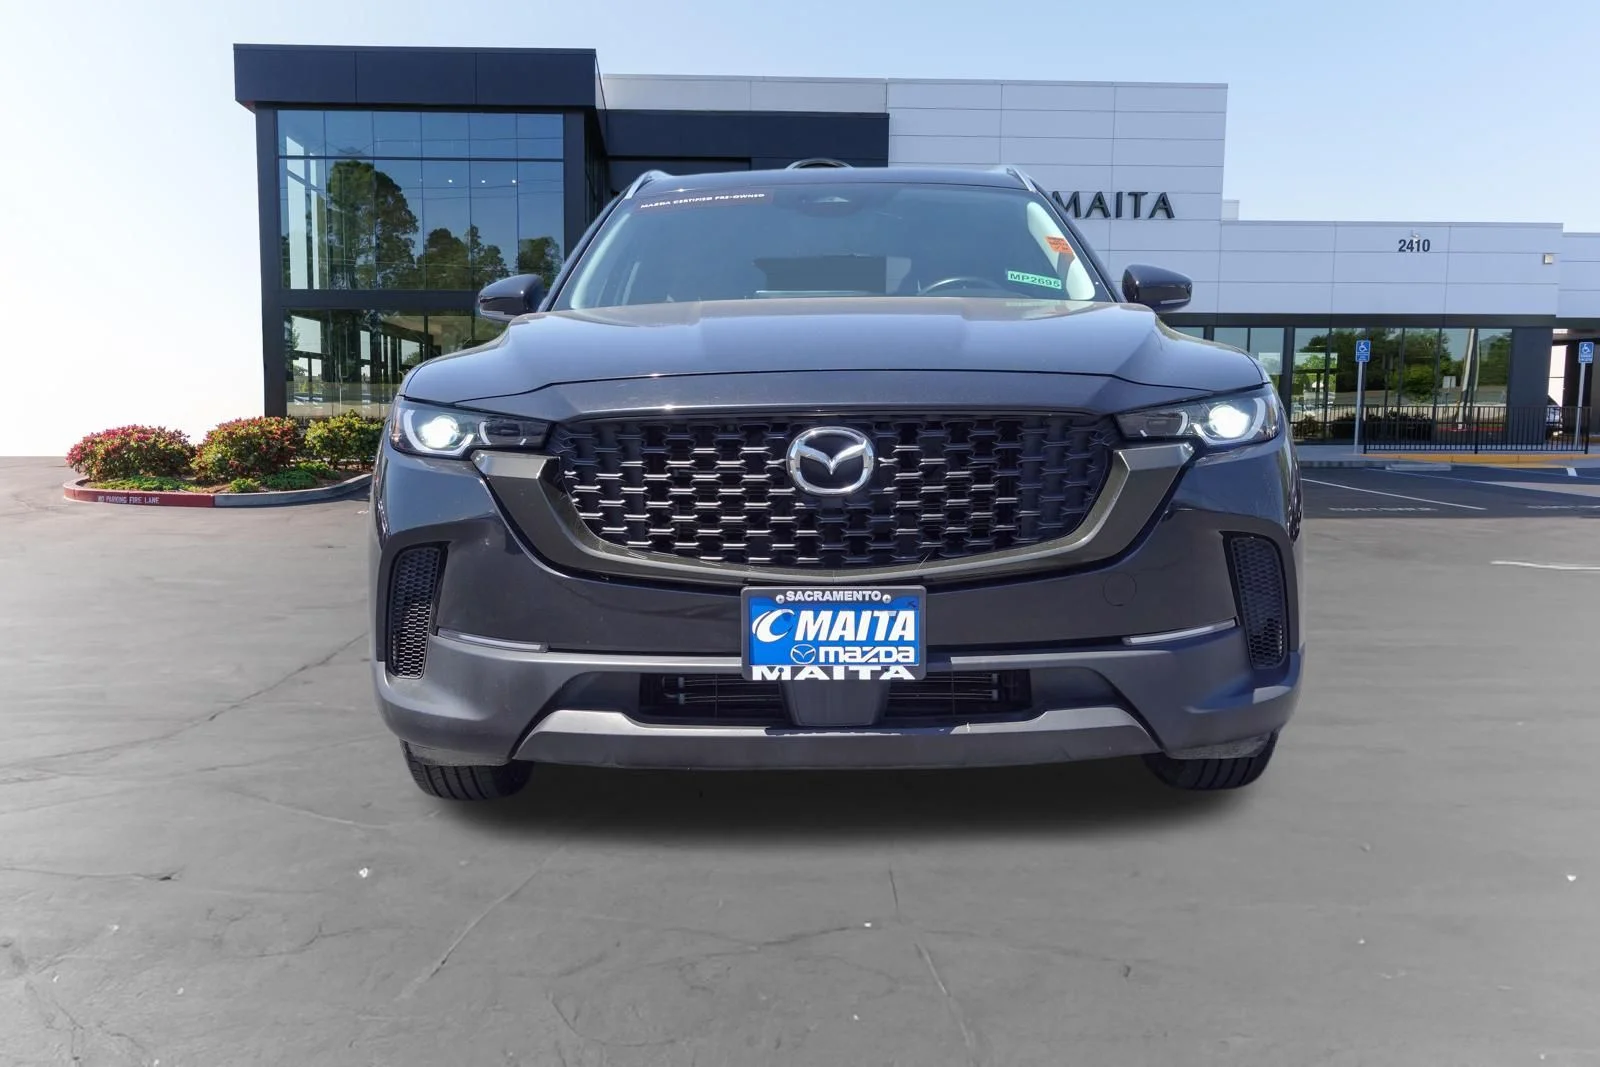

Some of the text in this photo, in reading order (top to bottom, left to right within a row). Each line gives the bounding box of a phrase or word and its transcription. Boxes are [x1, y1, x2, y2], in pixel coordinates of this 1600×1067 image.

[640, 200, 671, 209] MAZDA
[673, 196, 713, 204] CERTIFIED
[1052, 191, 1175, 219] MAITA
[1398, 239, 1430, 253] 2410
[1010, 273, 1061, 288] MP2695
[144, 496, 160, 504] LANE
[786, 591, 881, 602] SACRAMENTO
[794, 610, 915, 642] MAITA
[819, 646, 915, 663] mazda
[752, 665, 916, 680] MAITA
